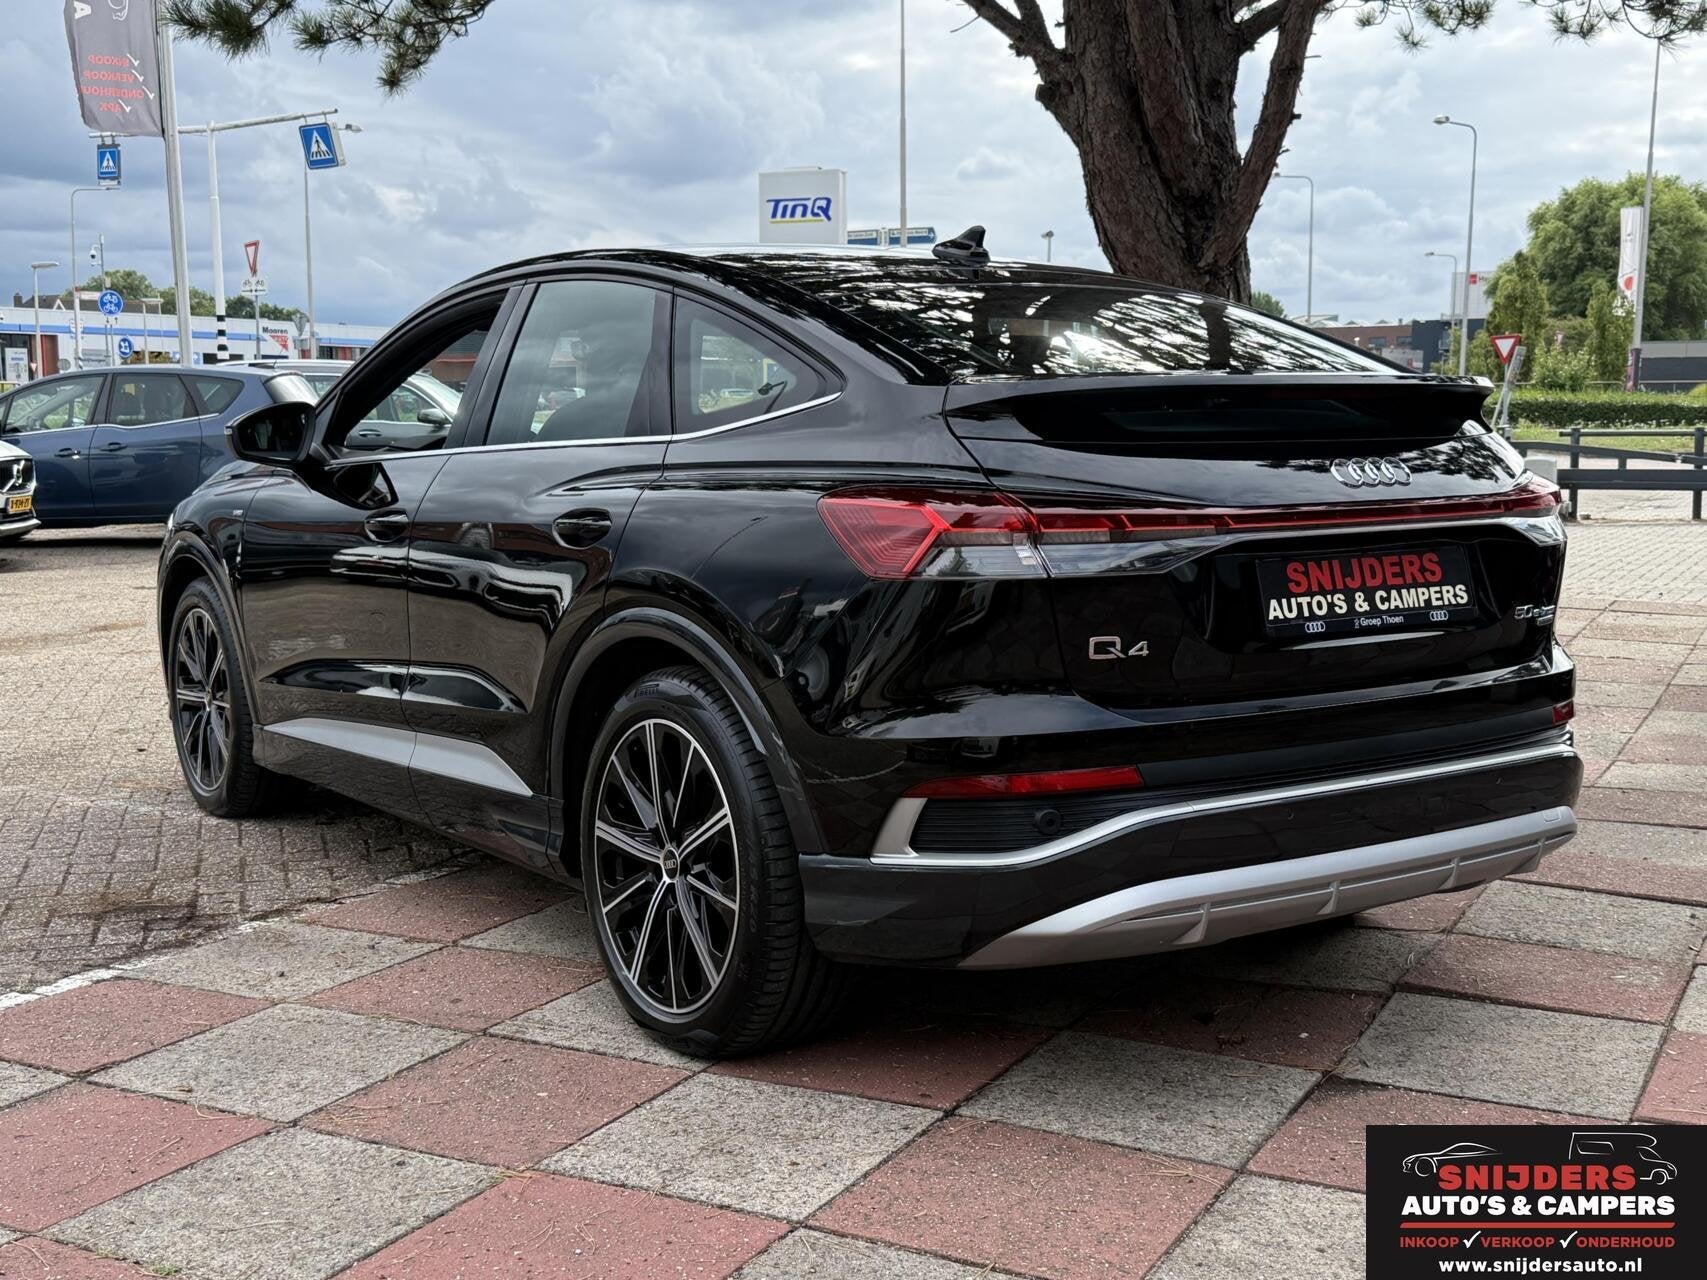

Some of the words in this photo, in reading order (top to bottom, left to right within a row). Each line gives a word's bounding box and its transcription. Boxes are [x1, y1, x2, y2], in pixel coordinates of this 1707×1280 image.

[766, 197, 832, 222] TinQ
[1286, 552, 1443, 594] SNIJDERS
[1268, 593, 1348, 620] AUTO'S
[1354, 592, 1370, 612] &
[1375, 584, 1469, 610] CAMPERS
[1360, 617, 1382, 627] Groep
[1382, 615, 1404, 624] Thoen
[1088, 635, 1150, 660] Q4
